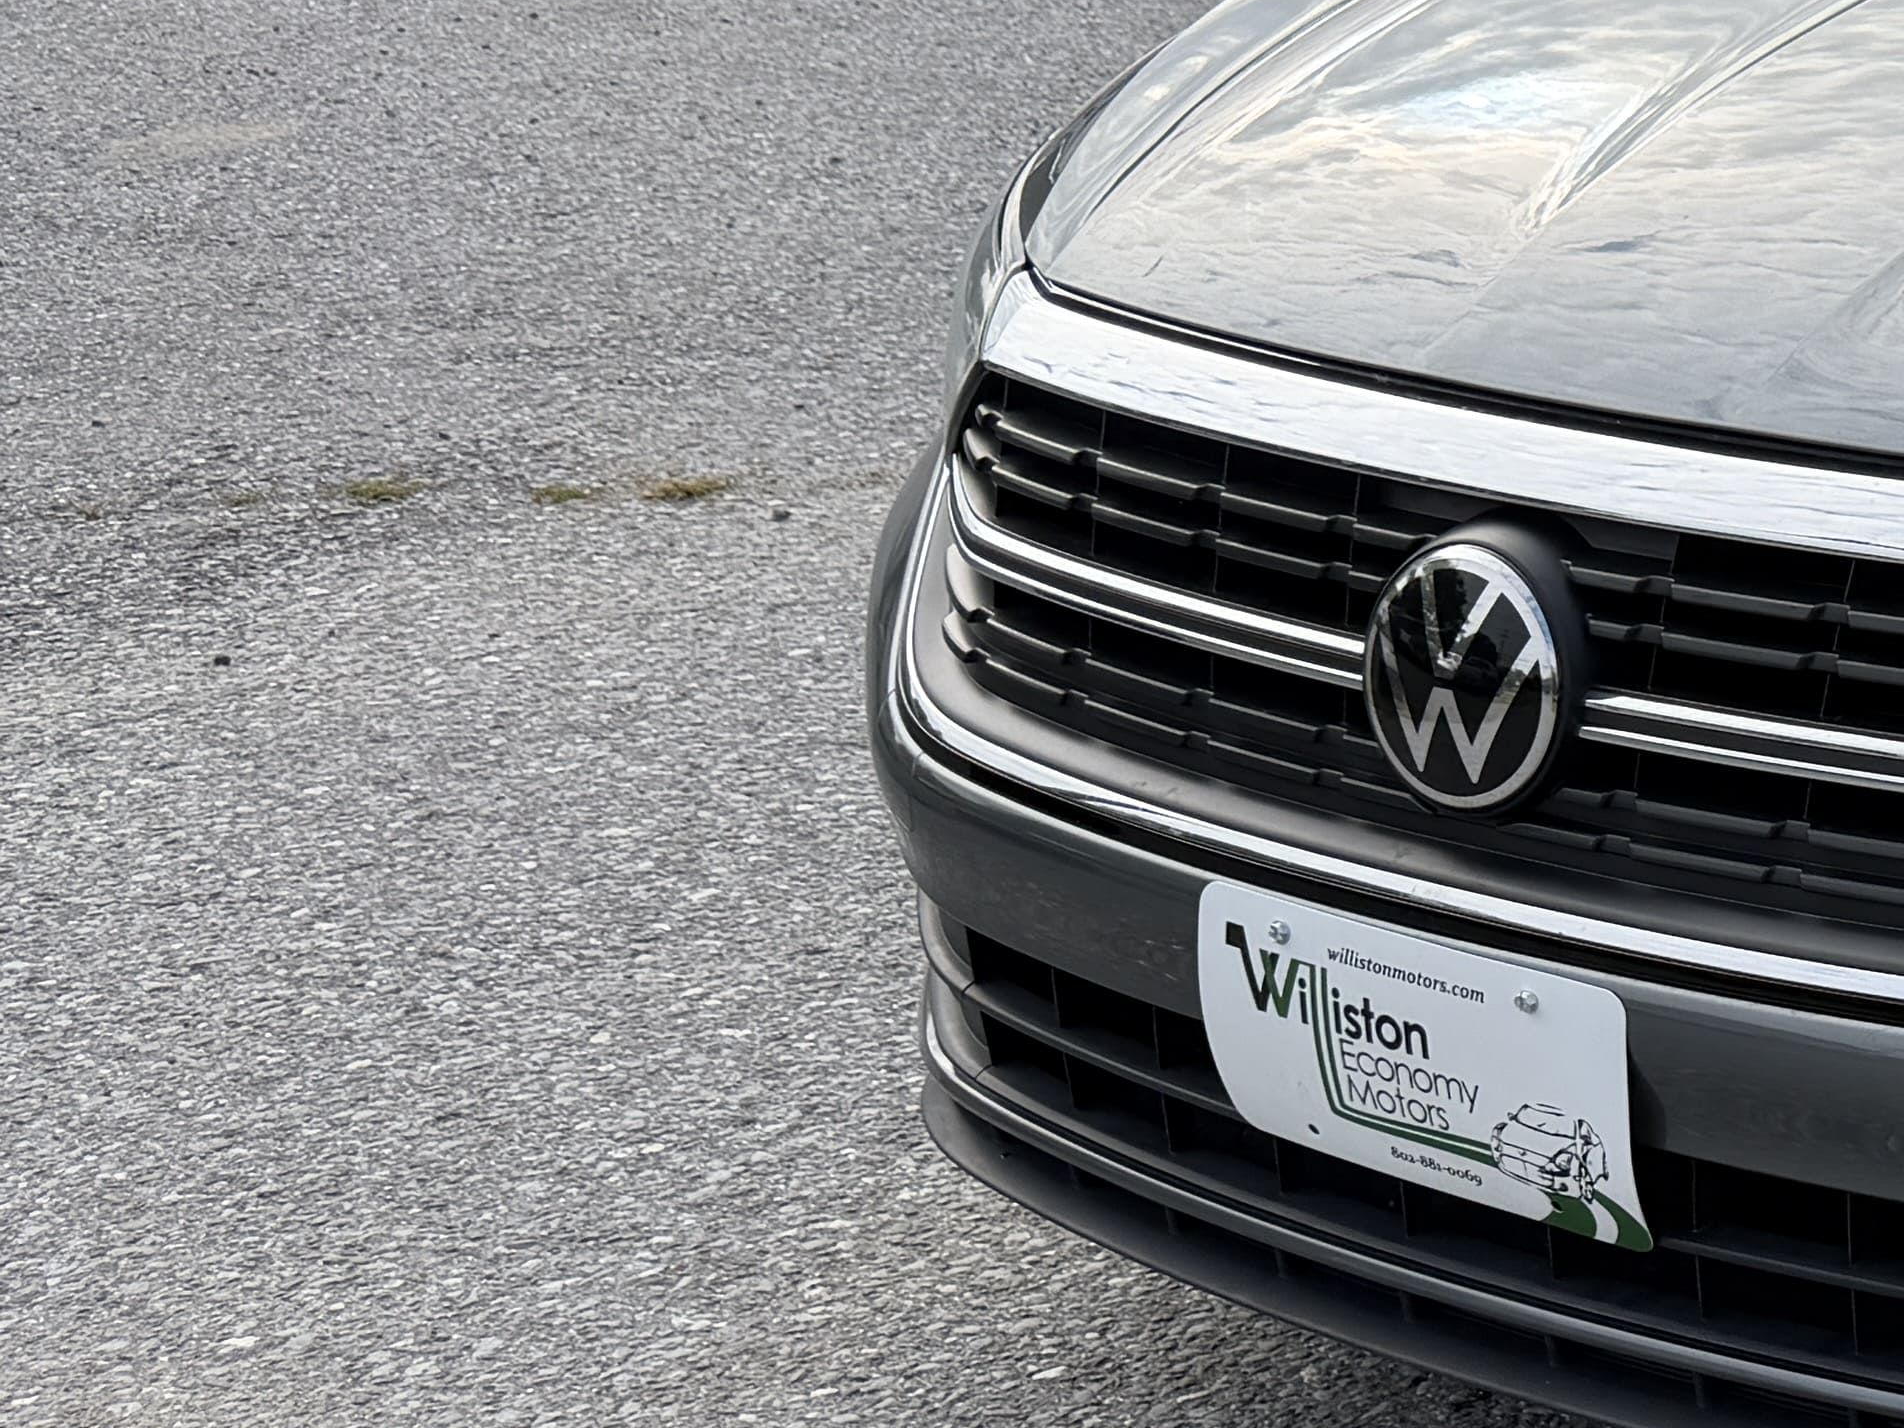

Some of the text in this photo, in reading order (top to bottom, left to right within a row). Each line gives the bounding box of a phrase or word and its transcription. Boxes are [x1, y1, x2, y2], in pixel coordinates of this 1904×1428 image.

[1225, 920, 1431, 1061] Williston
[1327, 947, 1486, 1004] willistonmotors.com
[1338, 1037, 1480, 1114] Economy
[1346, 1073, 1450, 1131] Motors
[1390, 1145, 1483, 1187] 802-881-0069
